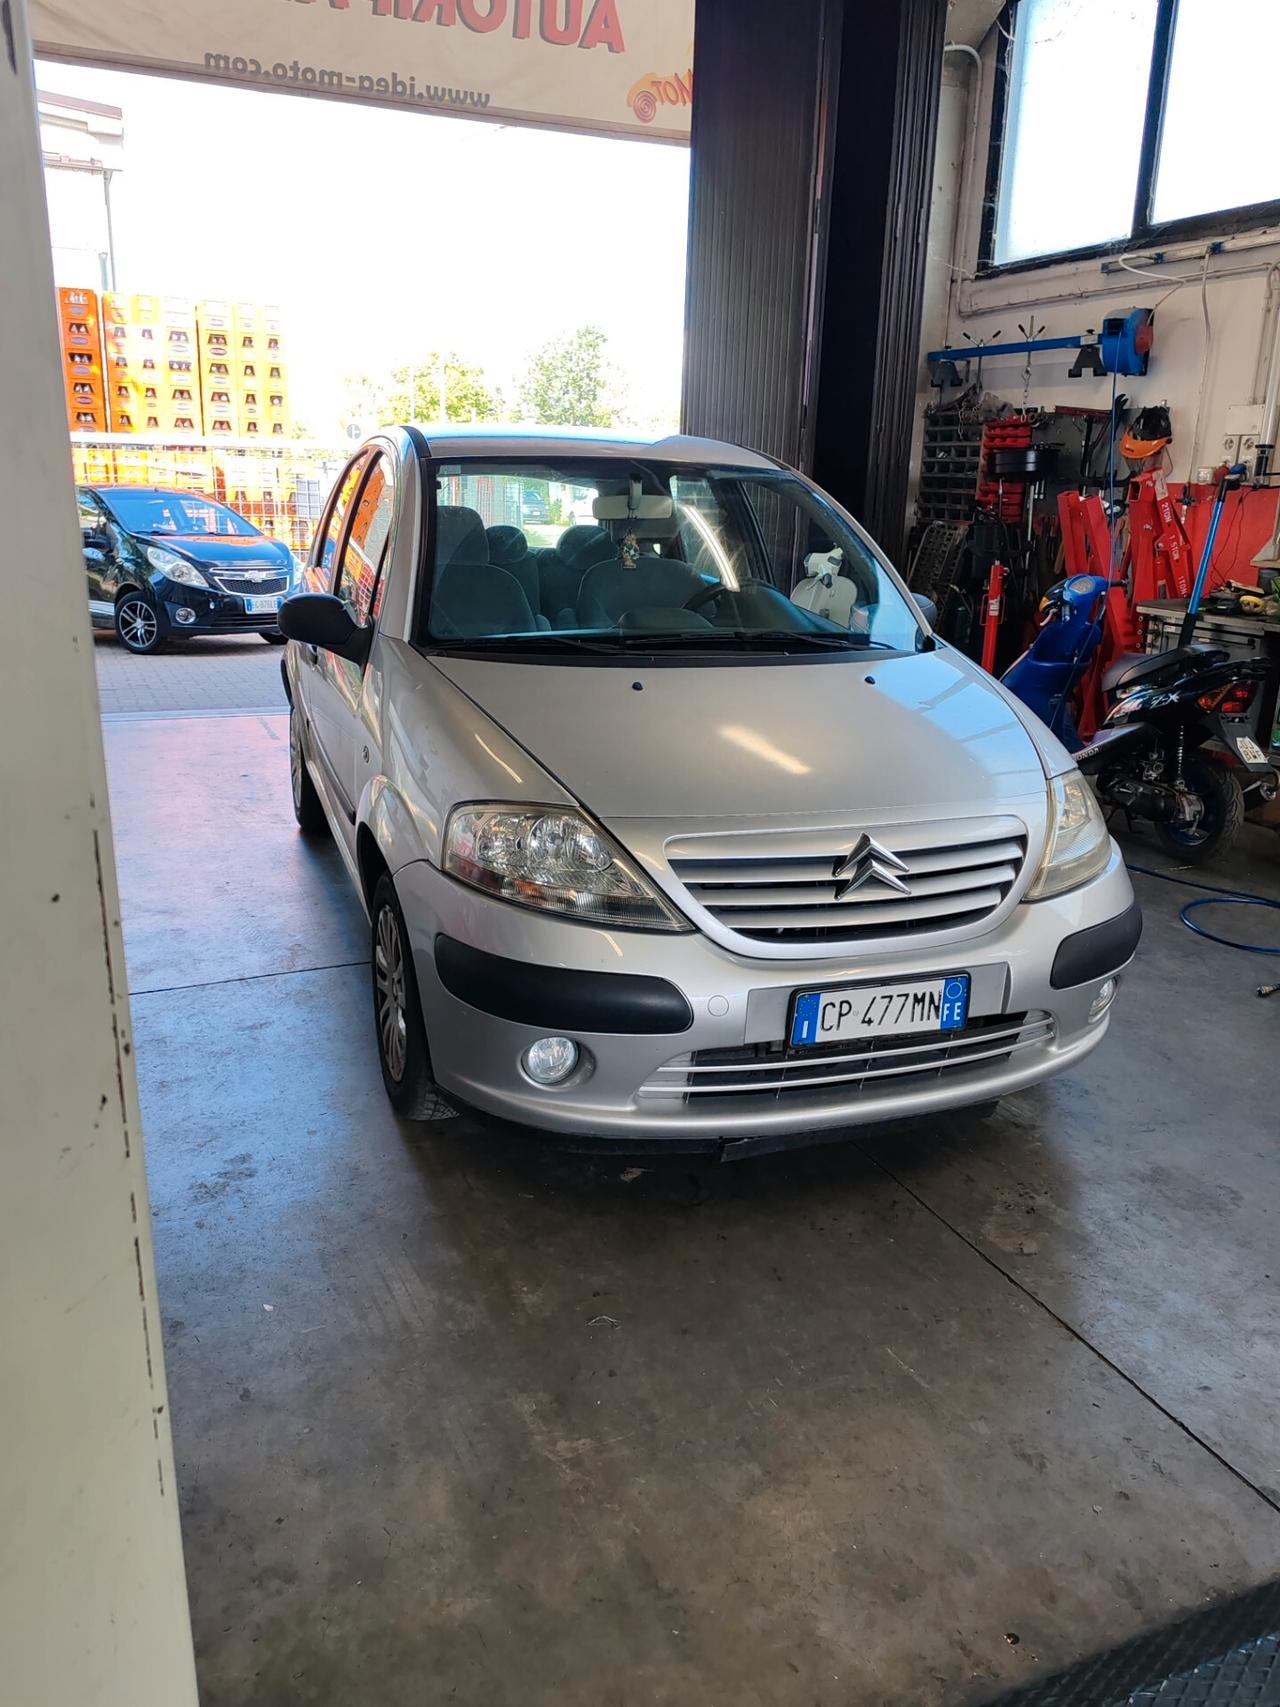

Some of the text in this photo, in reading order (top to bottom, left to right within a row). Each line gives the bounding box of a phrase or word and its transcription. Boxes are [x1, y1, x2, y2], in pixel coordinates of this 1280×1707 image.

[821, 991, 941, 1031] CP 477MN
[942, 1001, 962, 1022] FE
